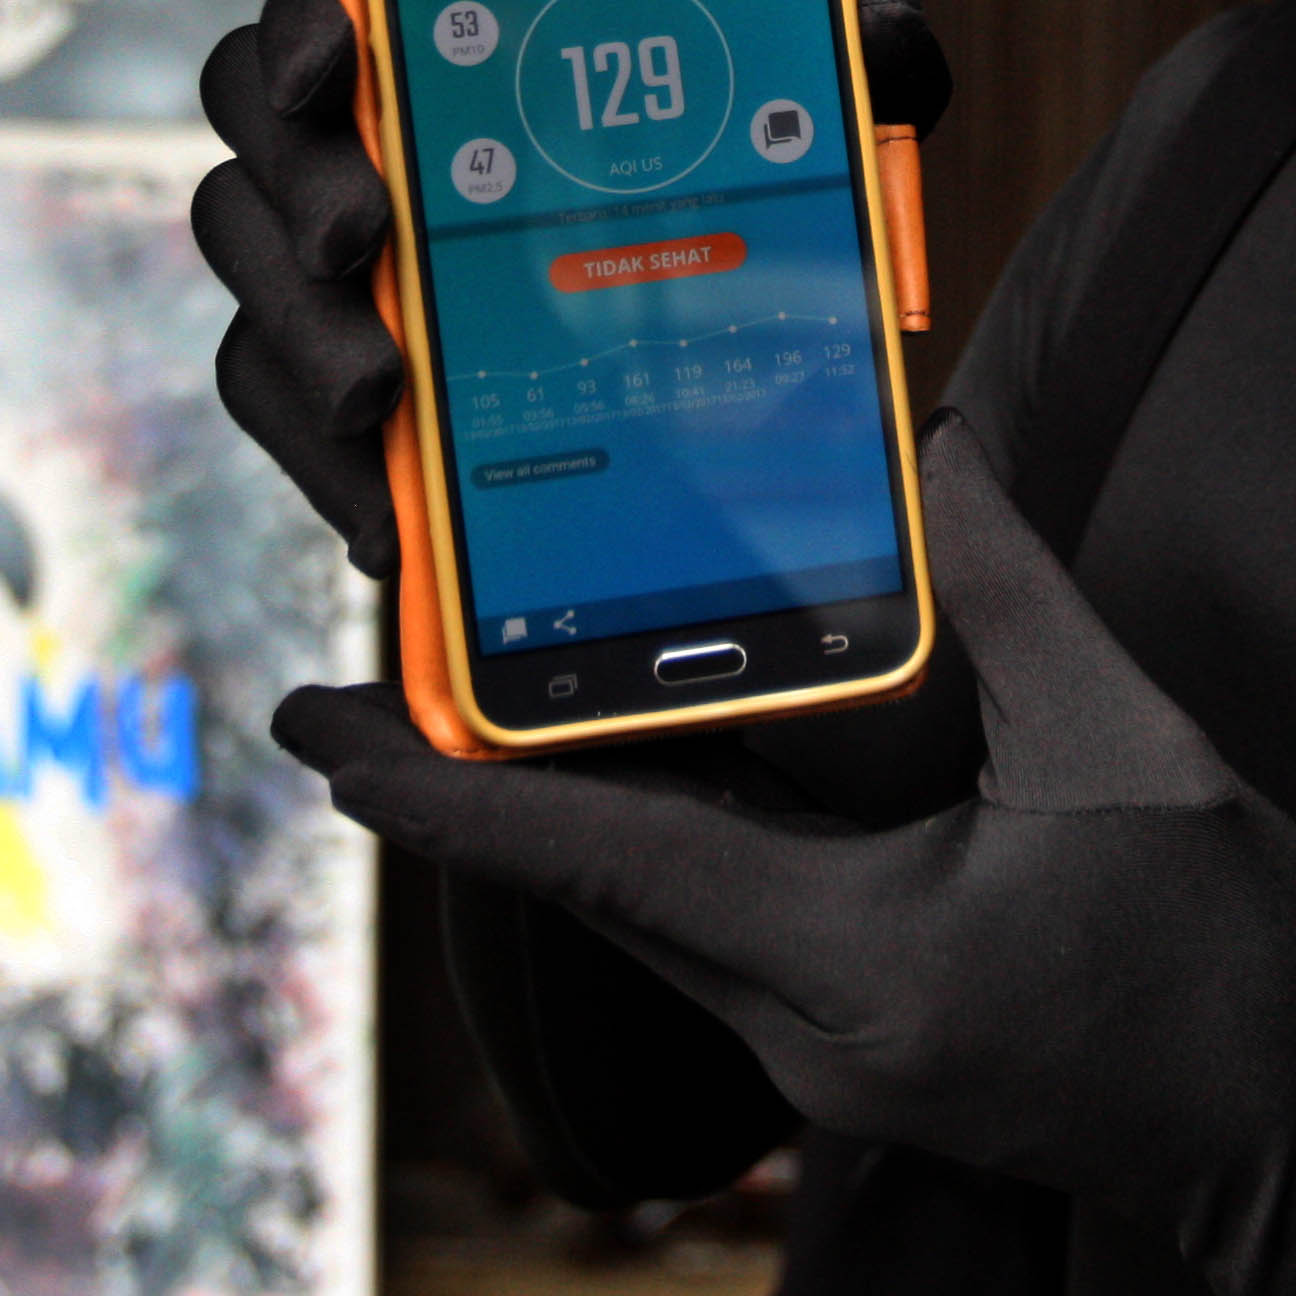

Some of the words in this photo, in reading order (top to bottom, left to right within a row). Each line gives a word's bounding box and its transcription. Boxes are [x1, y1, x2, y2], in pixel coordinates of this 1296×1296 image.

[451, 10, 479, 38] 53
[561, 35, 685, 132] 129
[470, 148, 495, 175] 47
[609, 159, 637, 177] AQI
[642, 156, 664, 172] US
[584, 256, 645, 279] TIDAK
[650, 246, 713, 270] SEHAT
[473, 393, 501, 409] 105
[527, 386, 545, 402] 61
[577, 378, 597, 395] 93
[624, 372, 651, 388] 161
[674, 365, 703, 382] 119
[723, 358, 752, 374] 164
[775, 350, 802, 367] 196
[823, 343, 851, 360] 129
[486, 468, 514, 481] View
[517, 465, 531, 477] all
[533, 456, 597, 474] comments
